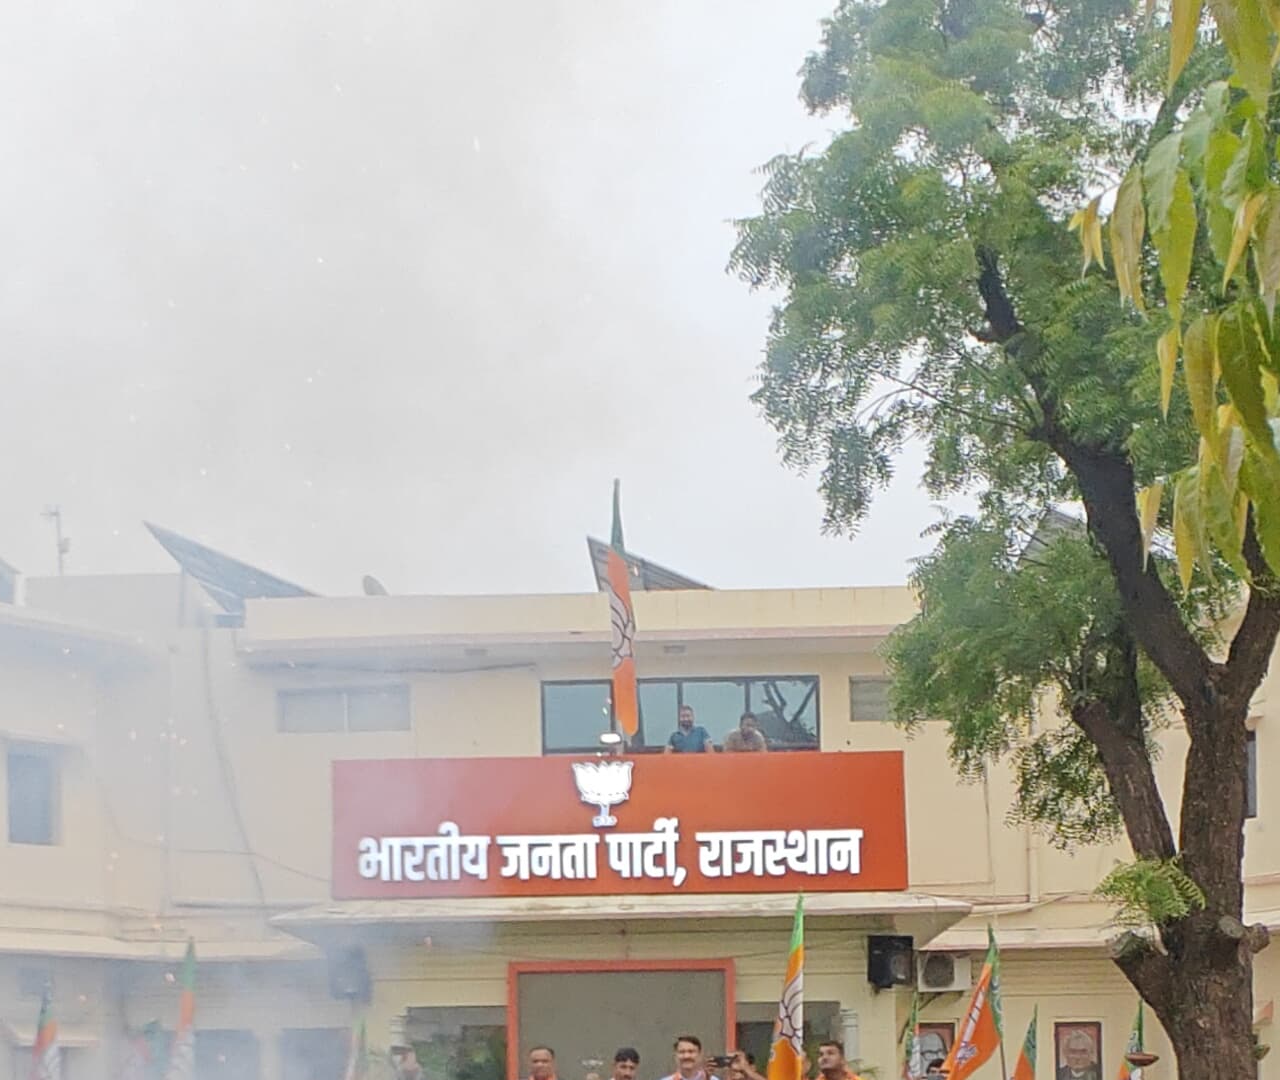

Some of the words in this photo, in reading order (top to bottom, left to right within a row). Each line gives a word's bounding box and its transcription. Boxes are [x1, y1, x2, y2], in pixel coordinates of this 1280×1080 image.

[359, 822, 490, 882] भारतीय
[496, 833, 600, 881] जनता
[606, 818, 687, 887] पार्टी,
[695, 828, 864, 880] राजस्थान
